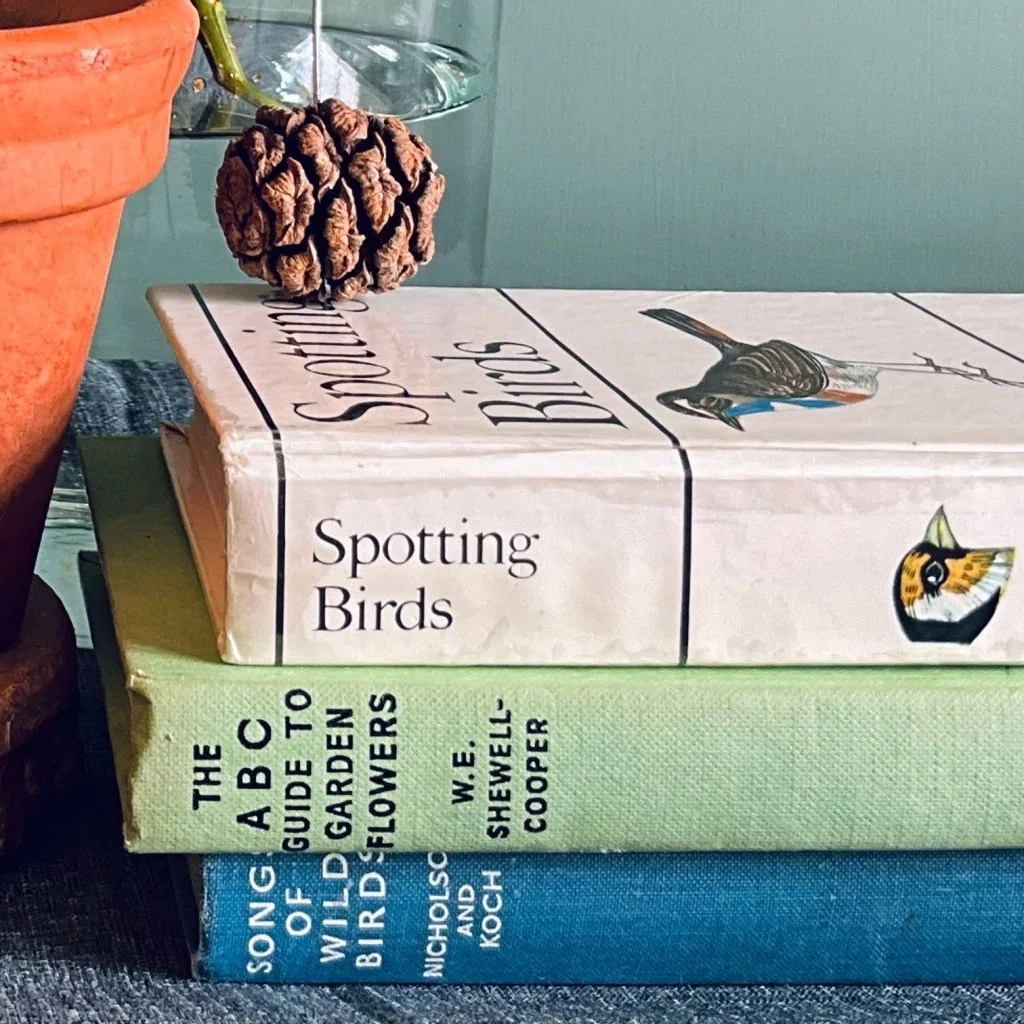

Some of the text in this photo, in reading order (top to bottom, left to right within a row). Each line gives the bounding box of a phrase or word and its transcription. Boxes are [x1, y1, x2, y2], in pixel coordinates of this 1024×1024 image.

[431, 342, 628, 429] Birds
[312, 517, 540, 579] Spotting
[313, 585, 453, 632] Birds
[192, 743, 222, 811] THE
[282, 688, 313, 851] GUIDE TO
[324, 708, 354, 840] GARDEN
[366, 693, 397, 849] FLOWERS
[486, 698, 512, 839] SHEWELL-
[524, 718, 549, 833] COOPER
[246, 852, 276, 974] SONG
[285, 887, 312, 937] OF
[320, 853, 350, 964] WILD
[456, 883, 476, 937] AND
[479, 870, 503, 948] KOCH
